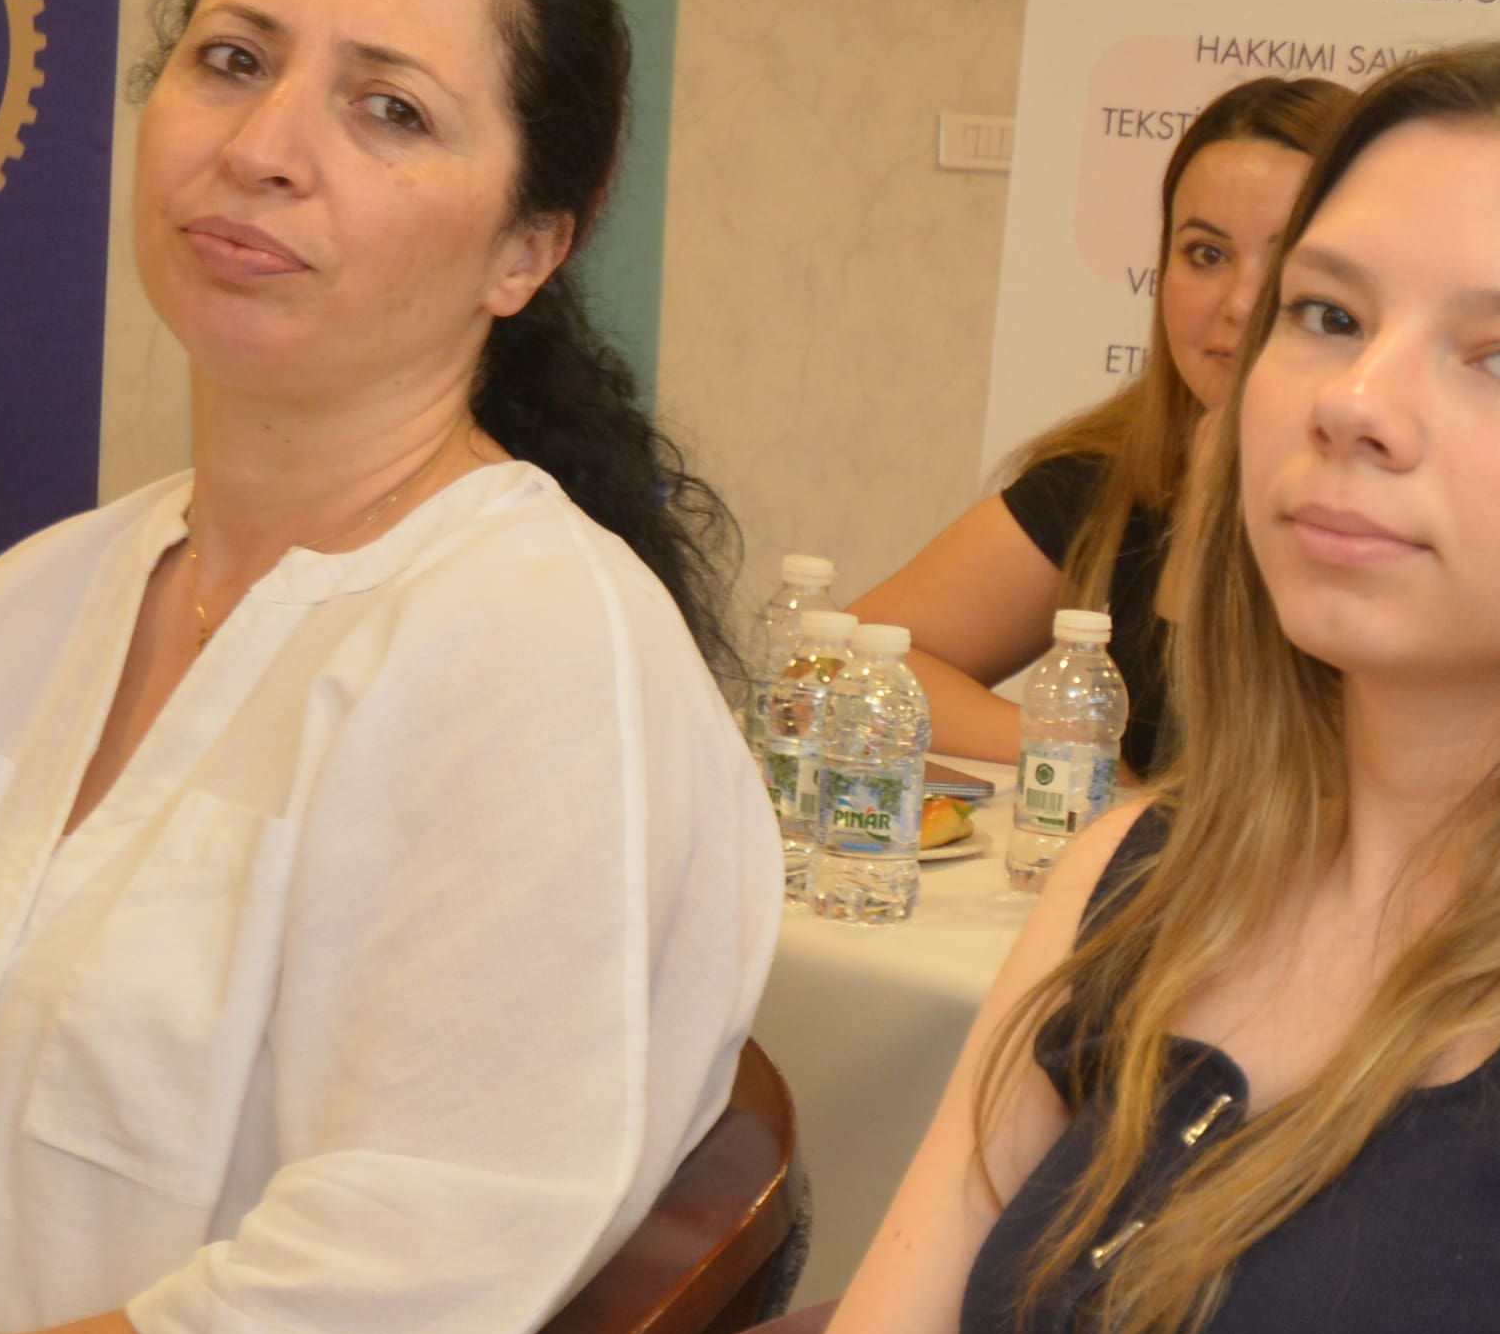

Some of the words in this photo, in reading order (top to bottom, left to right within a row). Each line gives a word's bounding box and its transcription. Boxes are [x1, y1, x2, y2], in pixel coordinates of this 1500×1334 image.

[1196, 35, 1336, 73] HAKKIMI
[1347, 45, 1418, 75] SAV
[1102, 106, 1200, 140] TEKST
[833, 809, 892, 830] PINAR
